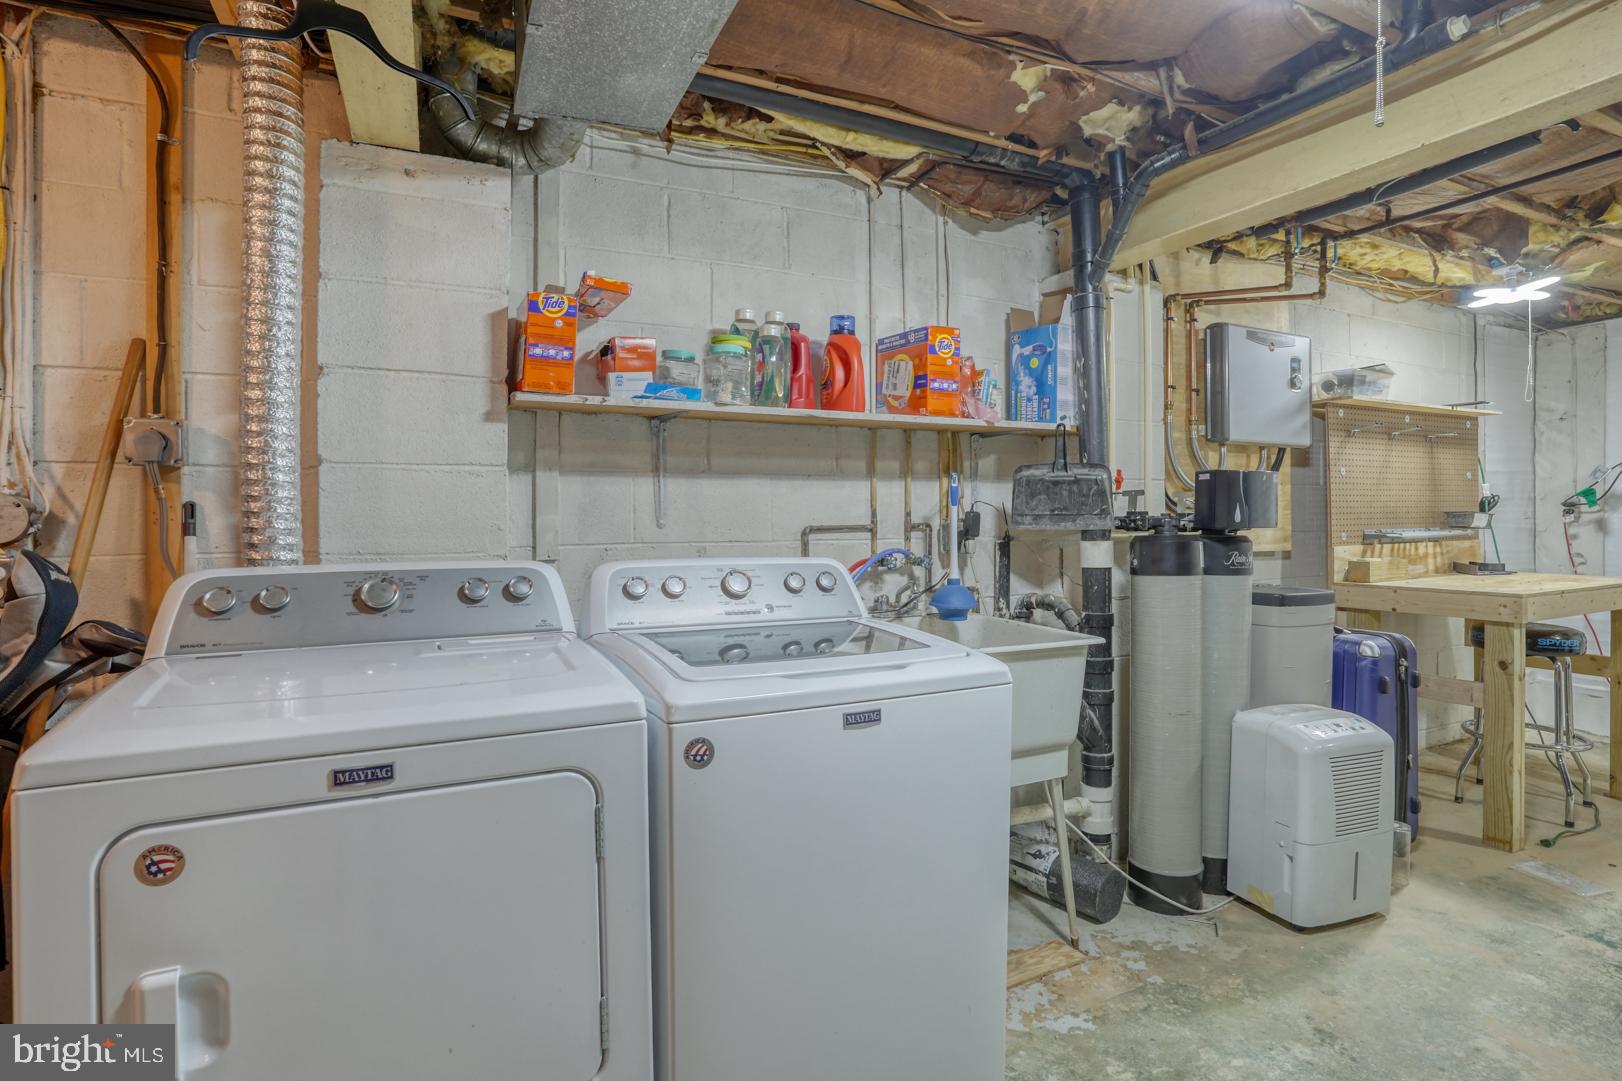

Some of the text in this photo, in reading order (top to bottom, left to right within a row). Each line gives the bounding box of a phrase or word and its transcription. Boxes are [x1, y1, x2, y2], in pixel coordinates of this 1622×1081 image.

[541, 295, 566, 311] Tide
[938, 340, 953, 352] Tide
[1537, 637, 1580, 647] SPYDER
[845, 711, 881, 725] MAYTAG
[336, 767, 392, 784] MAYTAG
[142, 846, 183, 862] AMERICA
